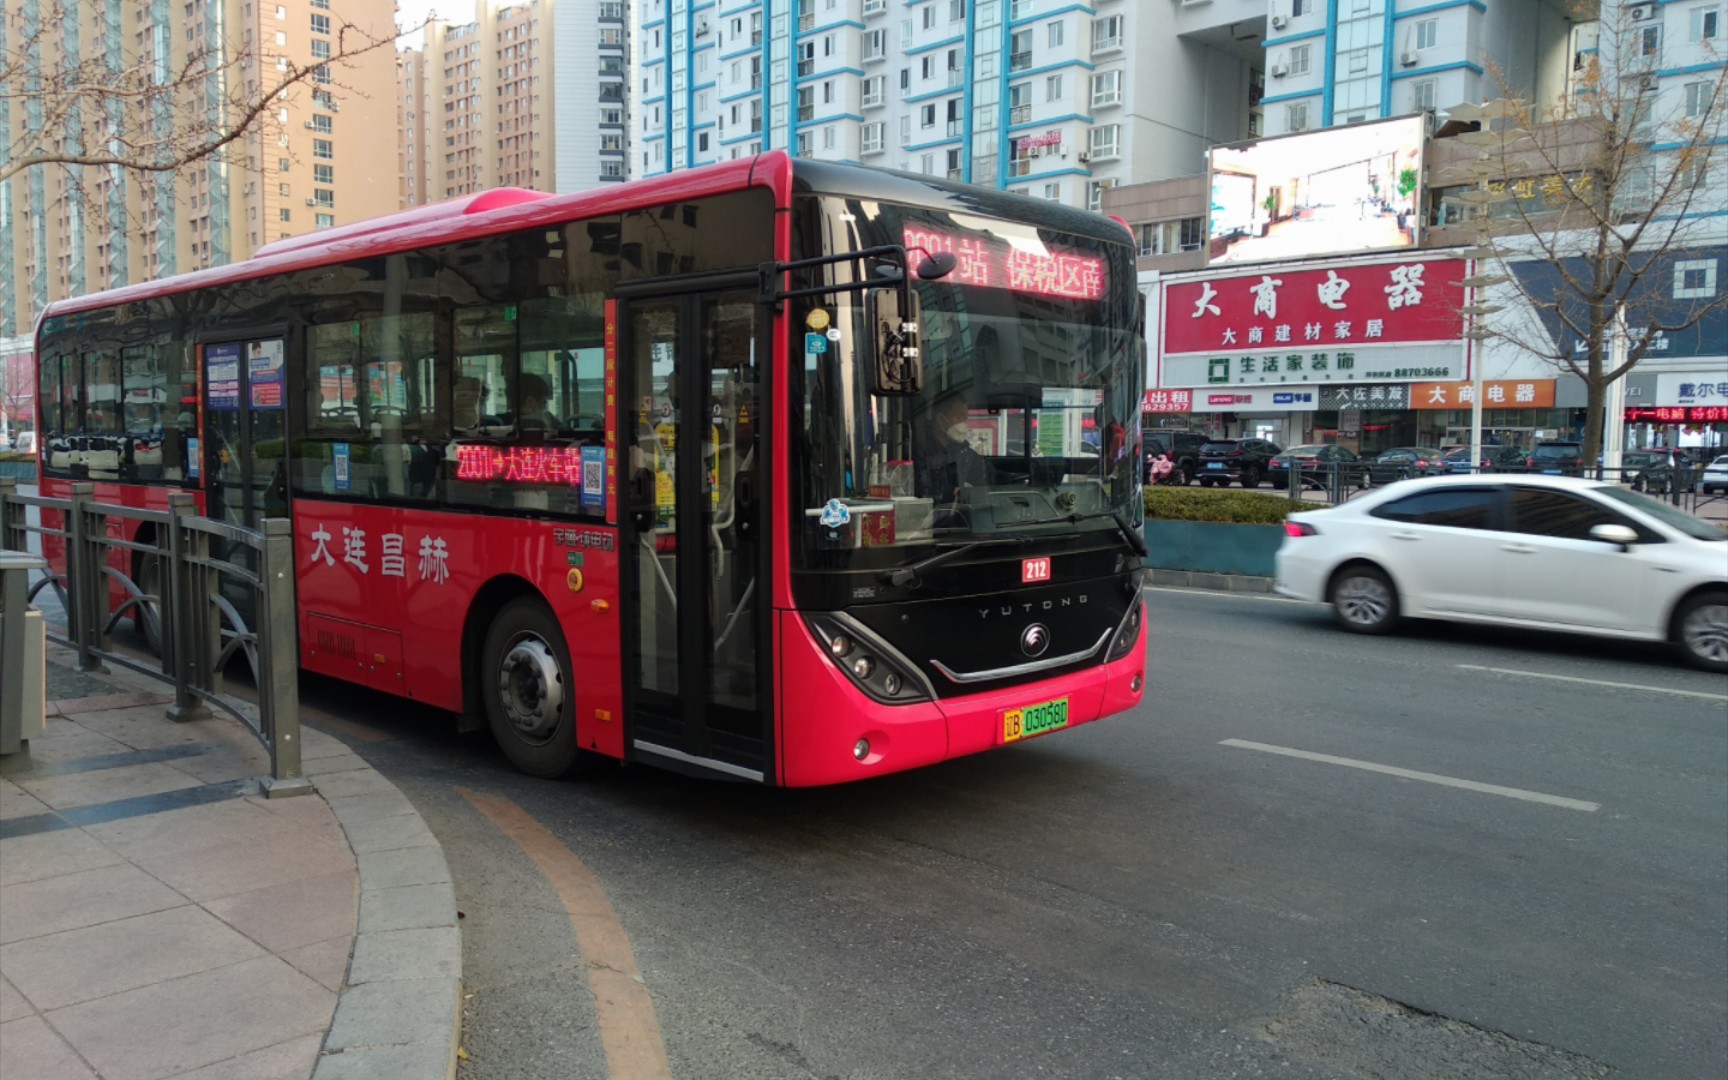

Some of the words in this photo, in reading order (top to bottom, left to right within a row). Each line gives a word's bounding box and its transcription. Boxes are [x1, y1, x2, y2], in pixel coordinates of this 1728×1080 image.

[1192, 263, 1425, 319] 大商电器
[1221, 319, 1385, 346] 大商建材家居
[1240, 352, 1355, 374] 生活家装饰
[1394, 366, 1449, 378] 88703666
[1142, 390, 1190, 404] 出租
[1336, 385, 1403, 401] 大佐美发
[1428, 383, 1535, 404] 大商电器
[310, 522, 450, 586] 大连昌赫
[1026, 561, 1046, 579] 212
[978, 594, 1088, 619] YUTONG
